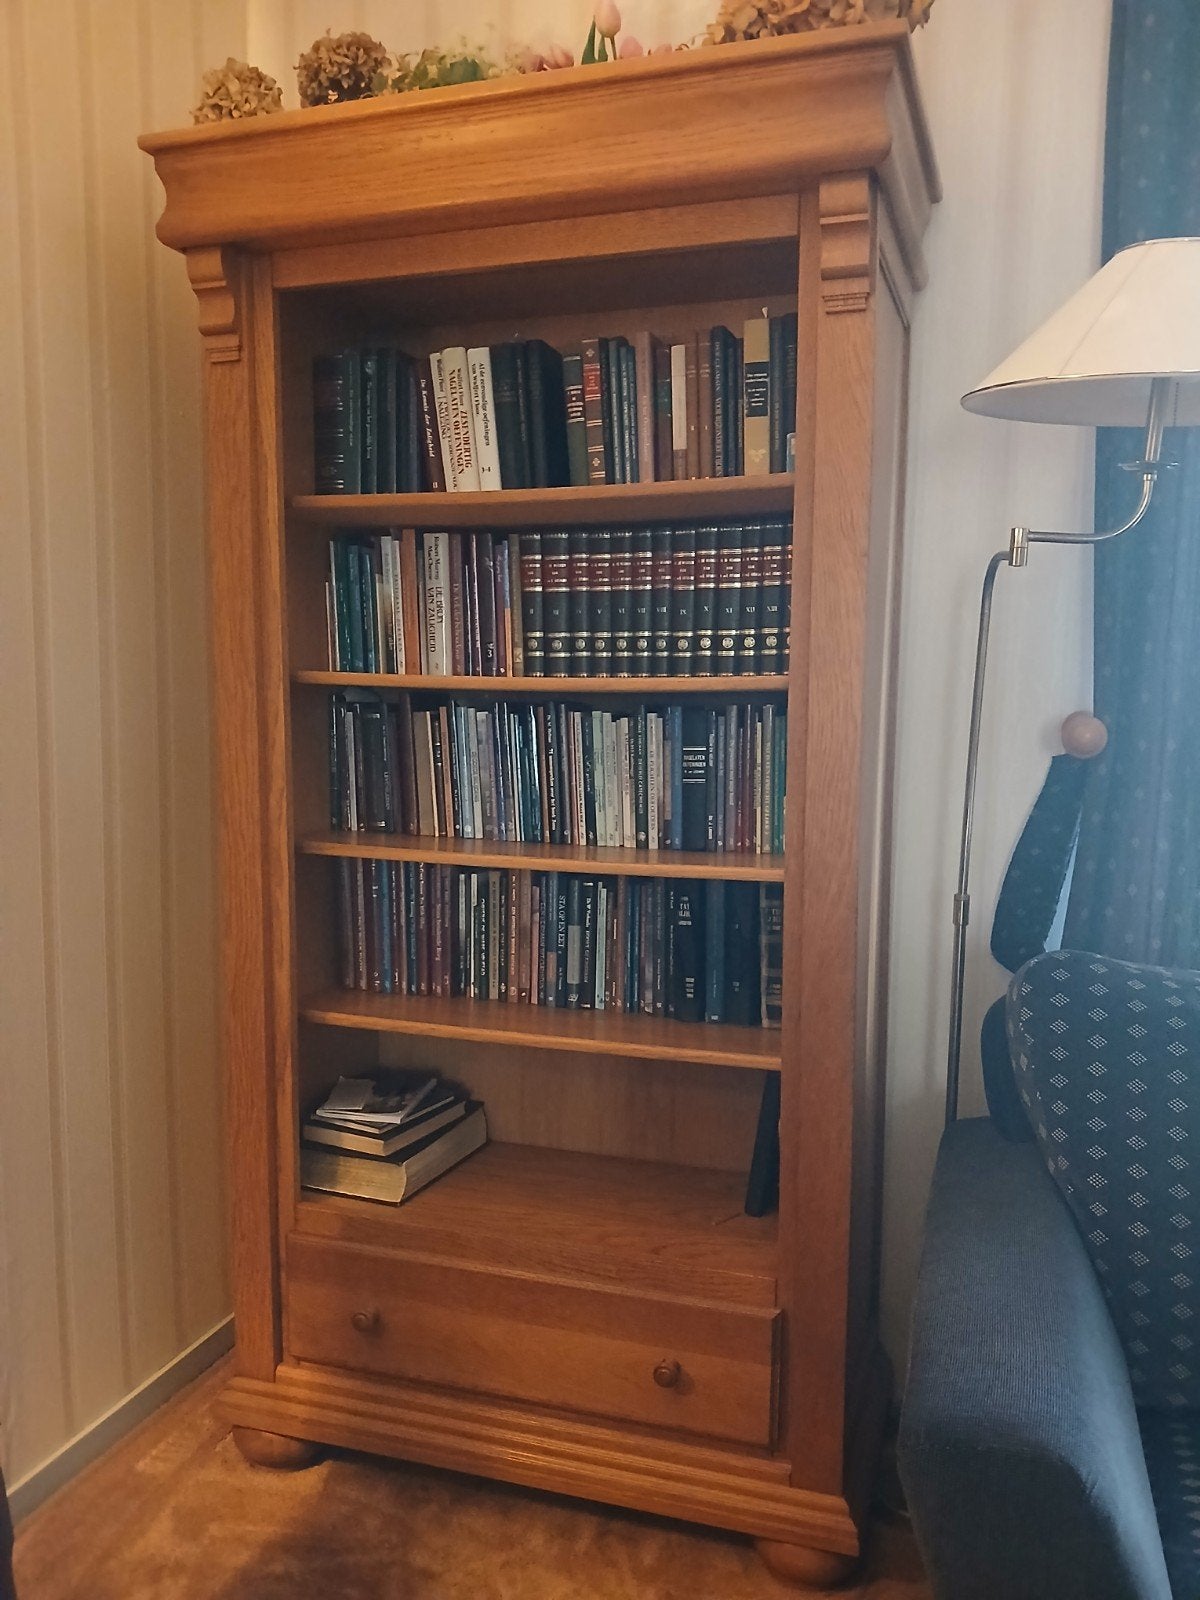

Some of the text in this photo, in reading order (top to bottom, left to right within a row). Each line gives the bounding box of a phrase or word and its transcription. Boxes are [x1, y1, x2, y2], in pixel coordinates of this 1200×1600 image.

[449, 369, 460, 418] NAGELATEN
[426, 428, 435, 457] Zaligheid
[453, 420, 464, 474] OEFENINGEN
[460, 410, 472, 468] ZESENDERTIG
[428, 608, 436, 653] ZALIGHEID
[558, 910, 565, 922] OP
[558, 922, 565, 932] EN
